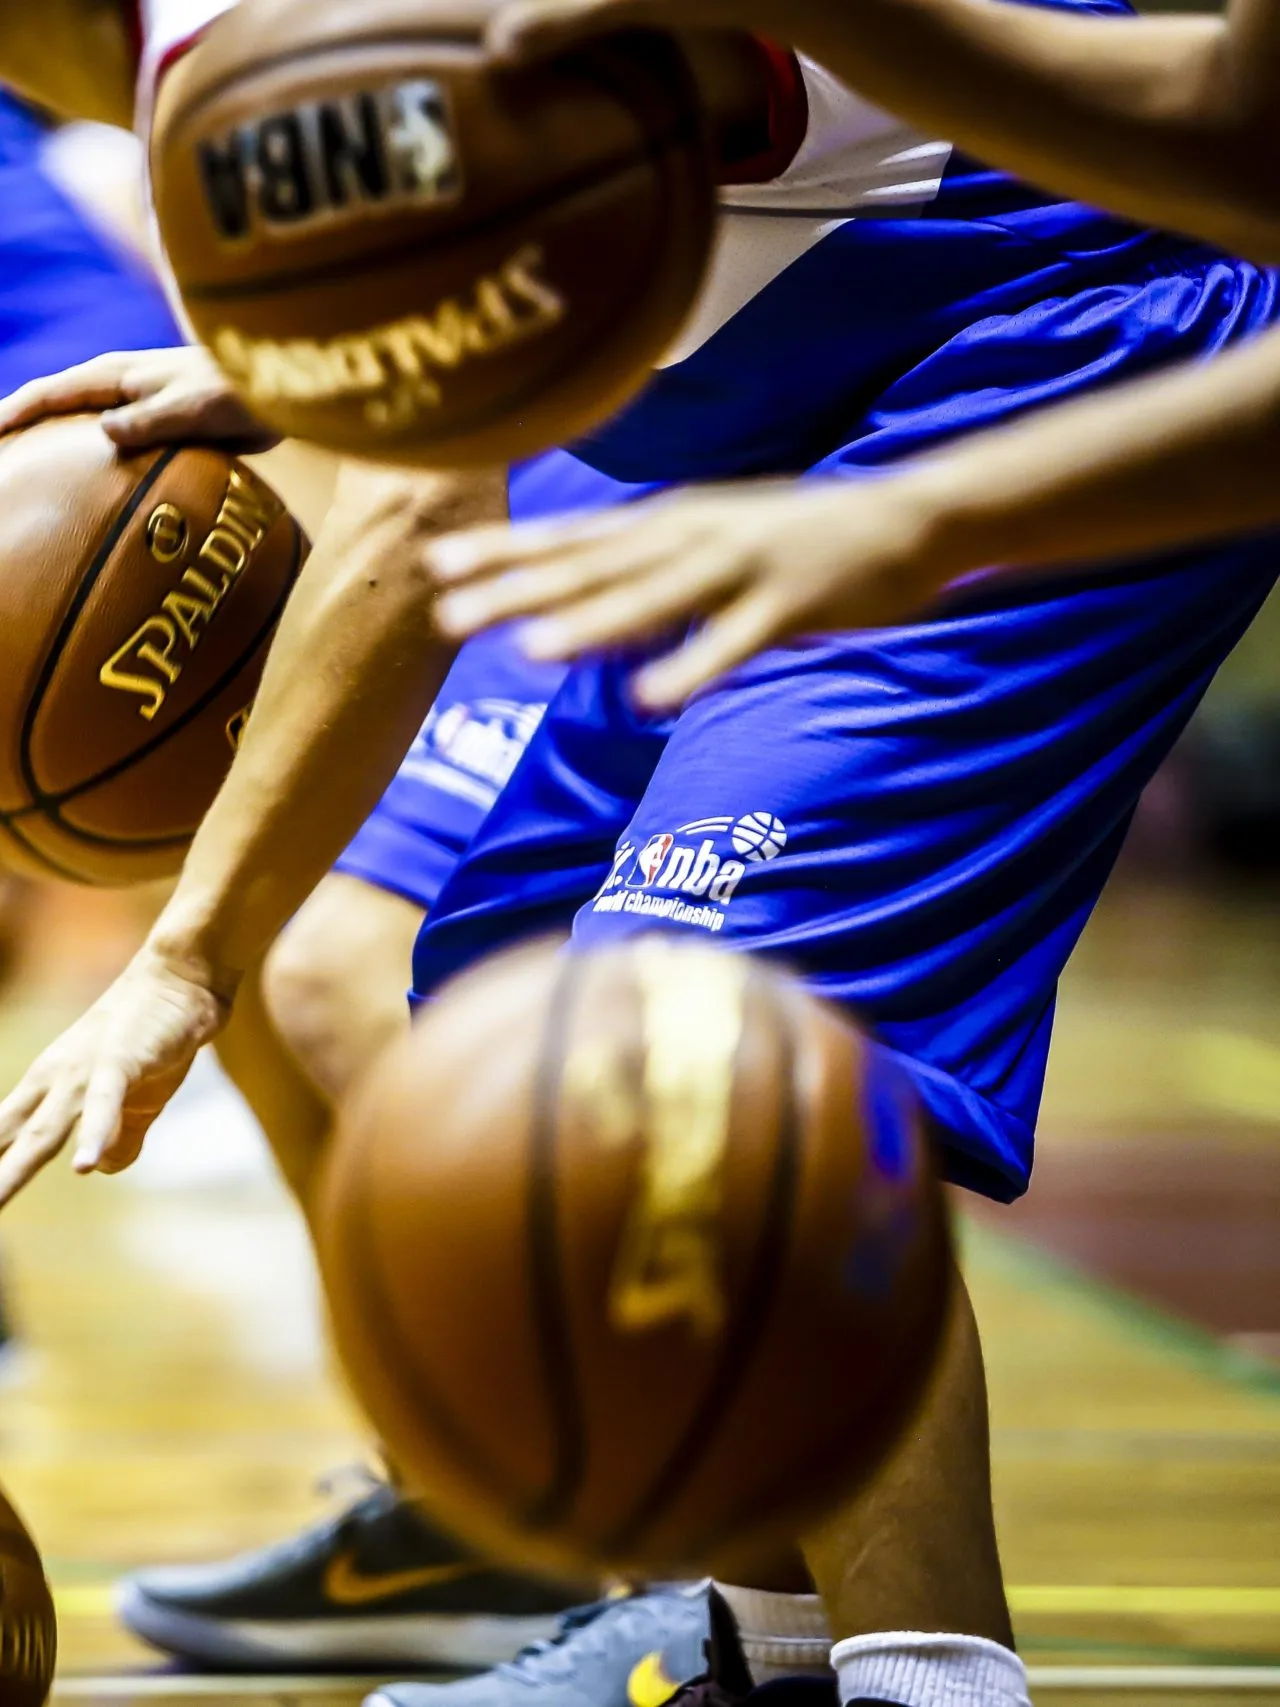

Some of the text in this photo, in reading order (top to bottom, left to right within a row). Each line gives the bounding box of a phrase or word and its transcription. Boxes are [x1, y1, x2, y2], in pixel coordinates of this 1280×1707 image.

[195, 90, 390, 241] NBA
[655, 838, 746, 906] nba
[624, 891, 725, 932] championship
